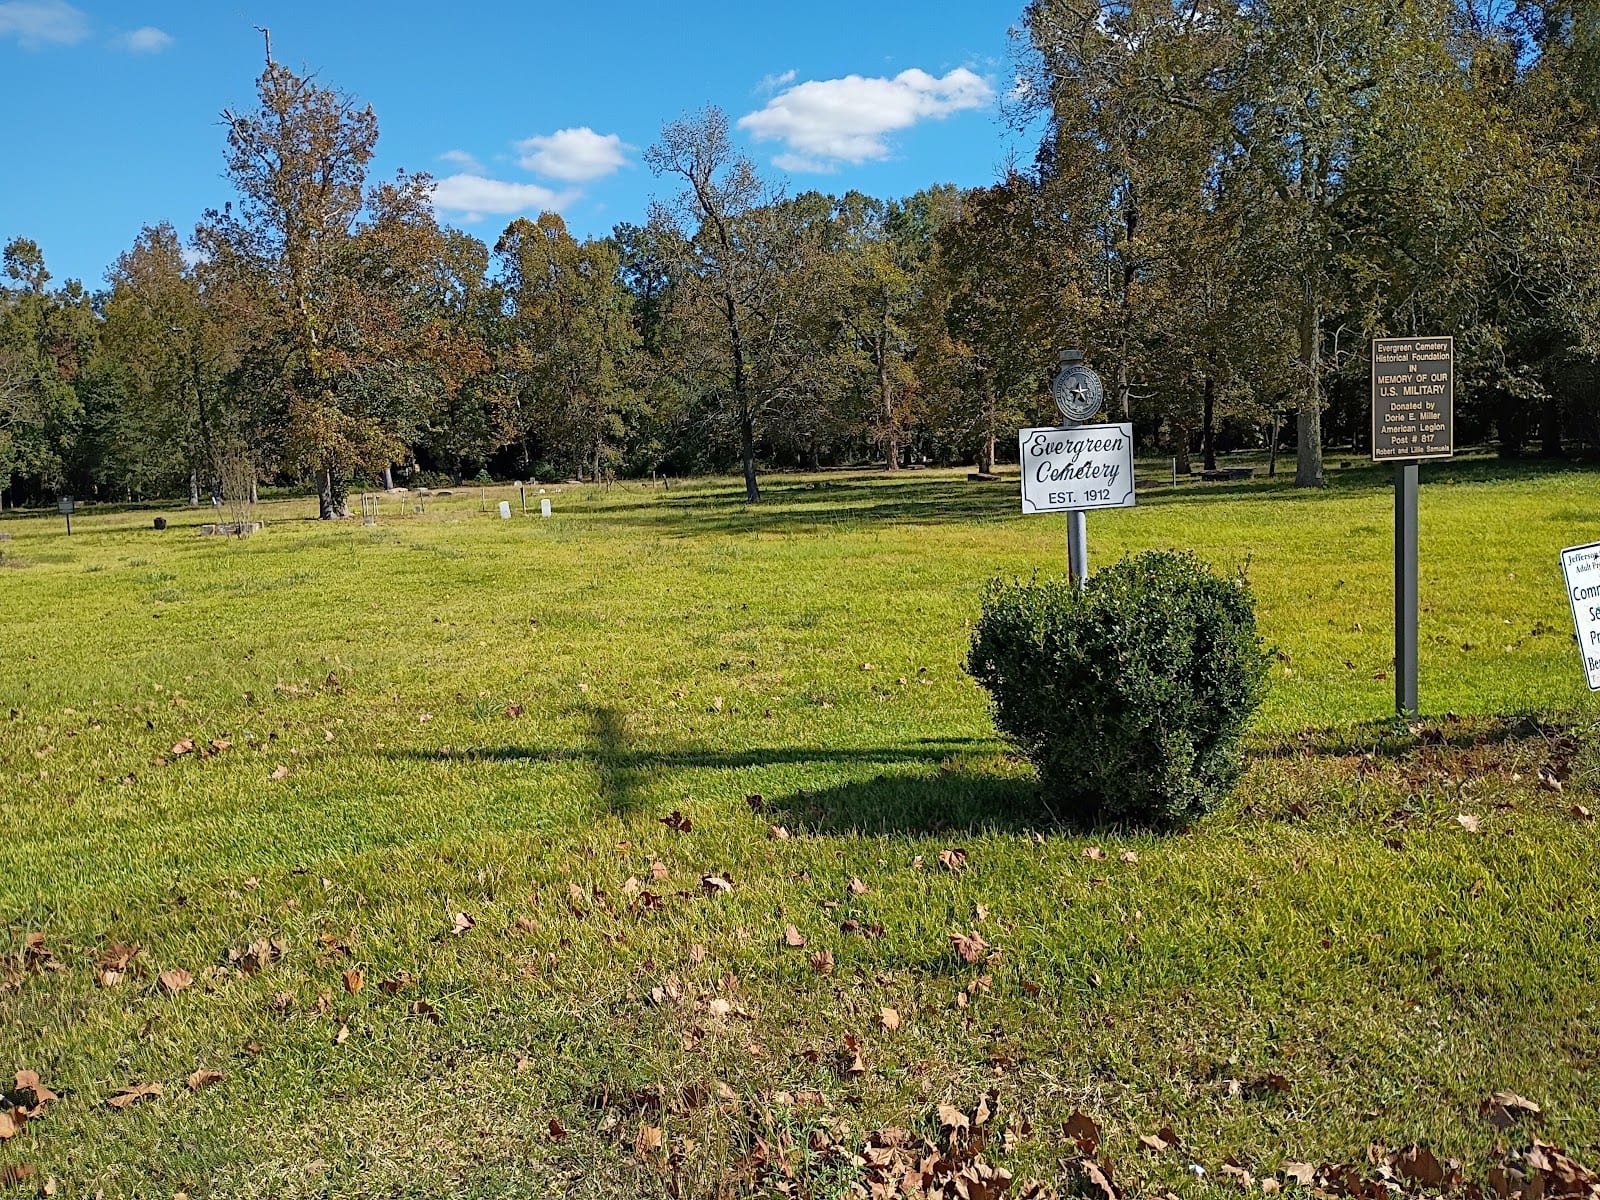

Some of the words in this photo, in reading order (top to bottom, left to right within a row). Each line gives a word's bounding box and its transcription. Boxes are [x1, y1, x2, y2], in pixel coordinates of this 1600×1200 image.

[1378, 344, 1412, 354] Evergreen
[1415, 342, 1448, 353] Cemetery
[1375, 354, 1409, 363] Historical
[1412, 352, 1450, 361] Foundation
[1408, 364, 1417, 373] IN
[1377, 375, 1412, 384] MEMORY
[1416, 374, 1427, 383] OF
[1431, 373, 1448, 382] OUR
[1380, 387, 1399, 397] U.S.
[1403, 385, 1445, 396] MILITARY
[1390, 401, 1422, 411] Donated
[1426, 401, 1436, 411] by
[1384, 413, 1405, 422] Dorie
[1408, 412, 1417, 421] E.
[1420, 411, 1441, 421] Miller
[1381, 424, 1416, 434] American
[1420, 423, 1445, 432] Legion
[1391, 436, 1408, 445] Post
[1411, 435, 1418, 444] #
[1421, 434, 1435, 443] 817
[1030, 434, 1123, 463] Evergreen
[1375, 448, 1396, 456] Robert
[1397, 446, 1409, 454] and
[1036, 460, 1120, 487] Cemetery
[1048, 491, 1077, 504] EST.
[1083, 488, 1110, 502] 1912
